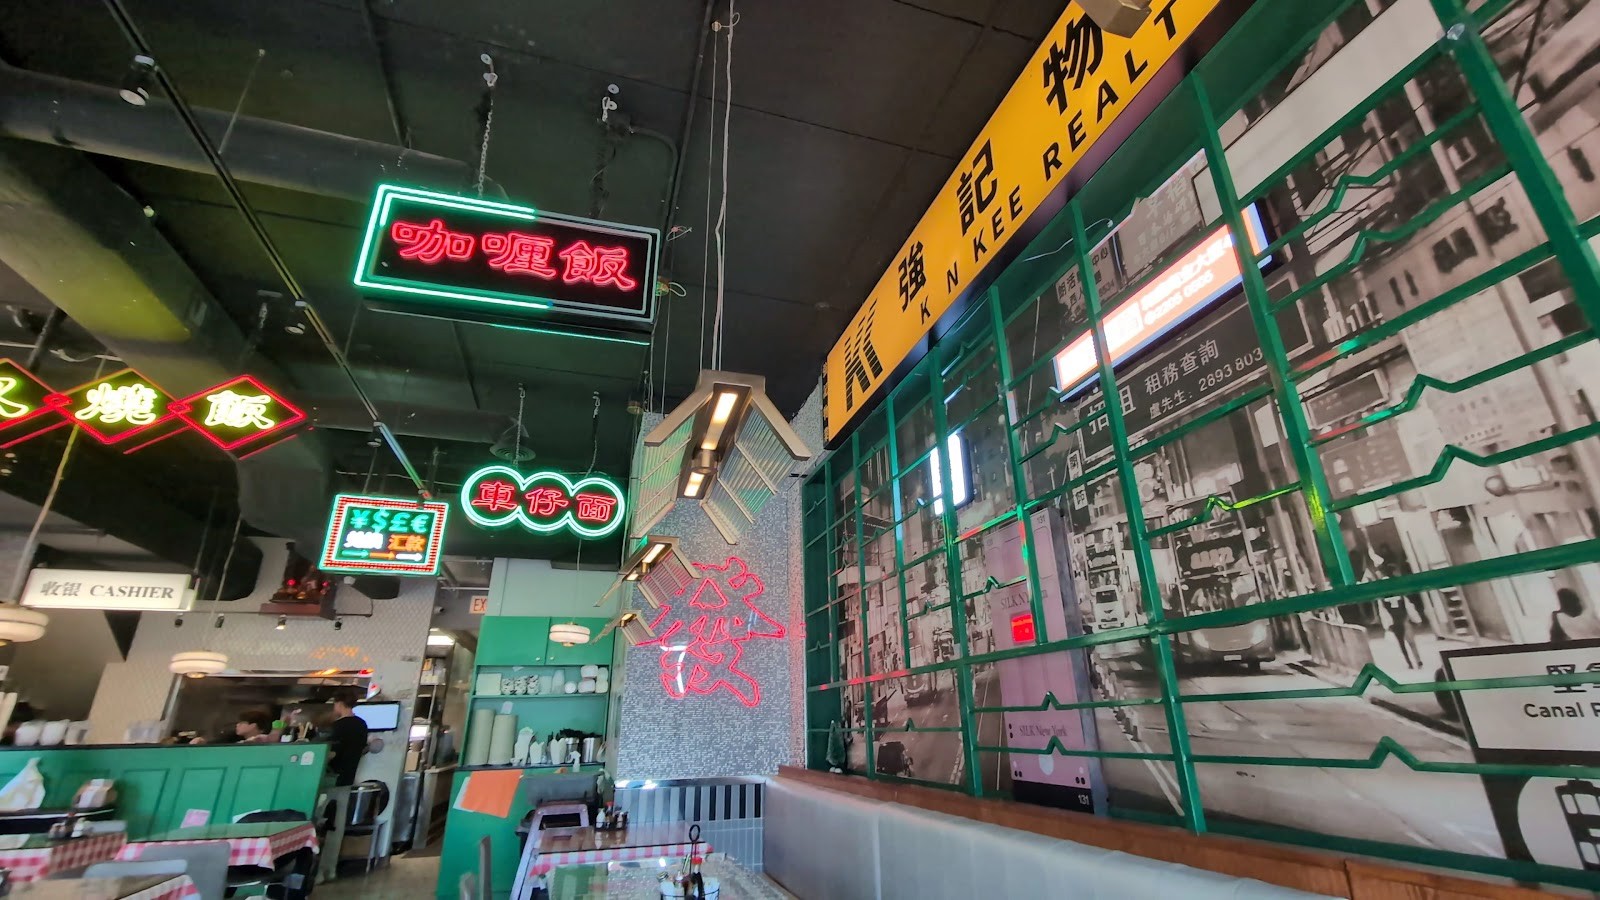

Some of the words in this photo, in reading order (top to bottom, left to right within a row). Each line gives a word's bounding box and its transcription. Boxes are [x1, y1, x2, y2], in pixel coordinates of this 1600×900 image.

[973, 185, 1023, 263] KEE
[391, 219, 636, 292] 咖喱飯
[1144, 339, 1219, 396] 租務查詢
[1198, 364, 1233, 392] 2893
[1235, 347, 1264, 371] 803
[471, 481, 617, 522] 車仔面
[387, 534, 427, 552] 汇款
[90, 584, 174, 599] CASHIER
[473, 598, 487, 612] EX
[1524, 702, 1585, 718] Canal
[1020, 725, 1035, 737] SILK
[1036, 725, 1051, 737] New
[1051, 725, 1068, 737] York
[1078, 794, 1090, 806] 131
